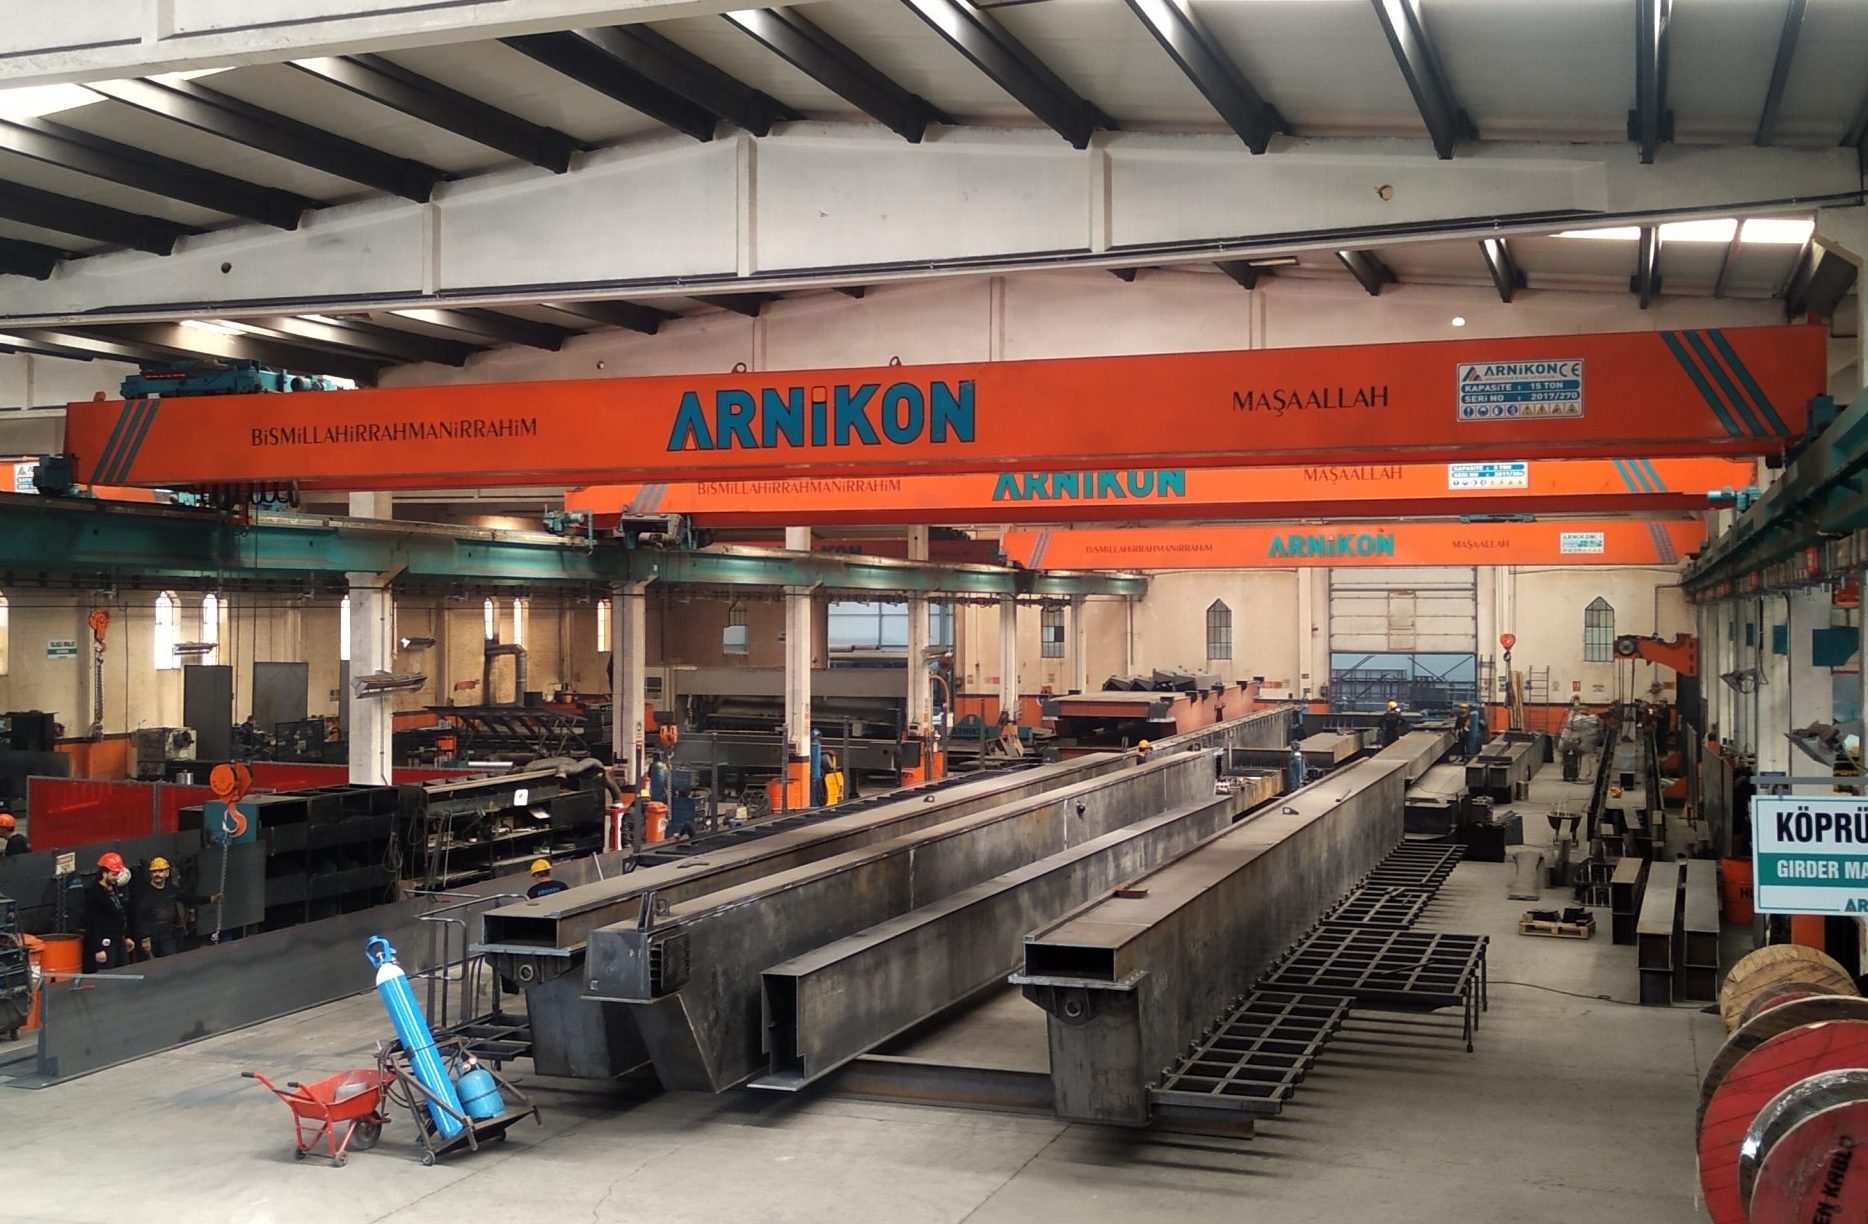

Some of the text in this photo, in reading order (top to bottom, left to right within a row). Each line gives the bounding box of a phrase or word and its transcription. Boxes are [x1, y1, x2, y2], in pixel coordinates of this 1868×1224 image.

[1484, 363, 1558, 377] ARNiKON
[1544, 381, 1564, 389] TON
[1232, 386, 1389, 417] MAŞAALLAH
[1490, 394, 1505, 402] NO
[667, 380, 976, 451] ARNiKON
[1304, 466, 1403, 485] MAŞAALLAH
[1776, 806, 1868, 843] KÖPRÜ
[1777, 859, 1839, 879] GIRDER
